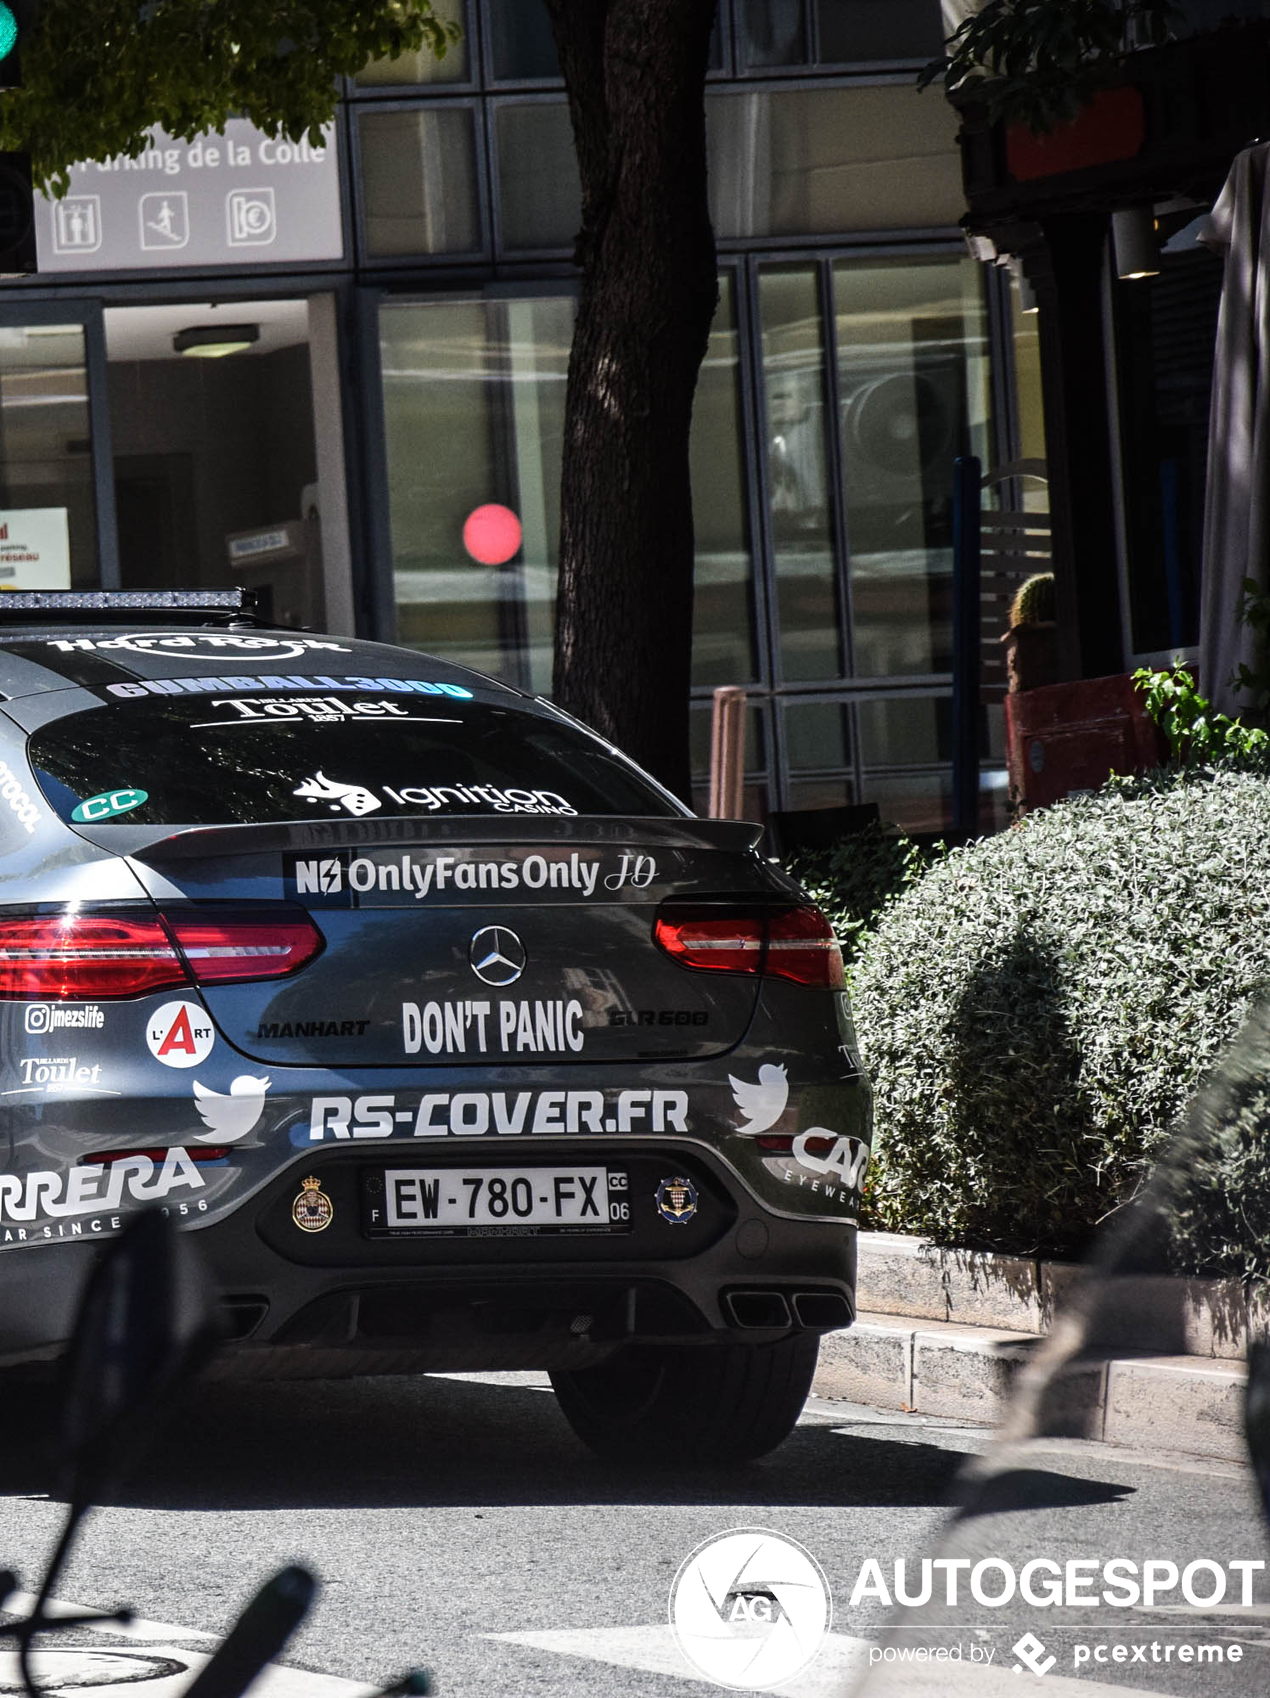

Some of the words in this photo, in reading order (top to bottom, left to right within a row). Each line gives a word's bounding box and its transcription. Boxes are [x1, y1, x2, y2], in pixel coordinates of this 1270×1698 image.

[187, 142, 220, 168] de
[228, 140, 252, 166] la
[257, 138, 327, 165] Colle
[46, 635, 197, 652] Hard
[196, 636, 353, 653] Rock
[211, 697, 409, 718] Toulet
[81, 790, 139, 819] CC
[382, 783, 572, 810] Ignition
[493, 803, 579, 816] CASINO
[49, 1005, 105, 1033] jmezslife
[257, 1020, 371, 1039] MANHART
[402, 1000, 491, 1054] DON'T
[498, 1000, 585, 1053] PANIC
[19, 1057, 102, 1084] Toulet
[308, 1090, 689, 1140] RS-COVER.FR
[608, 1176, 628, 1188] CC
[394, 1175, 601, 1220] EW-780-FX
[371, 1209, 380, 1222] F
[609, 1202, 630, 1221] 06
[43, 1216, 122, 1239] SINCE
